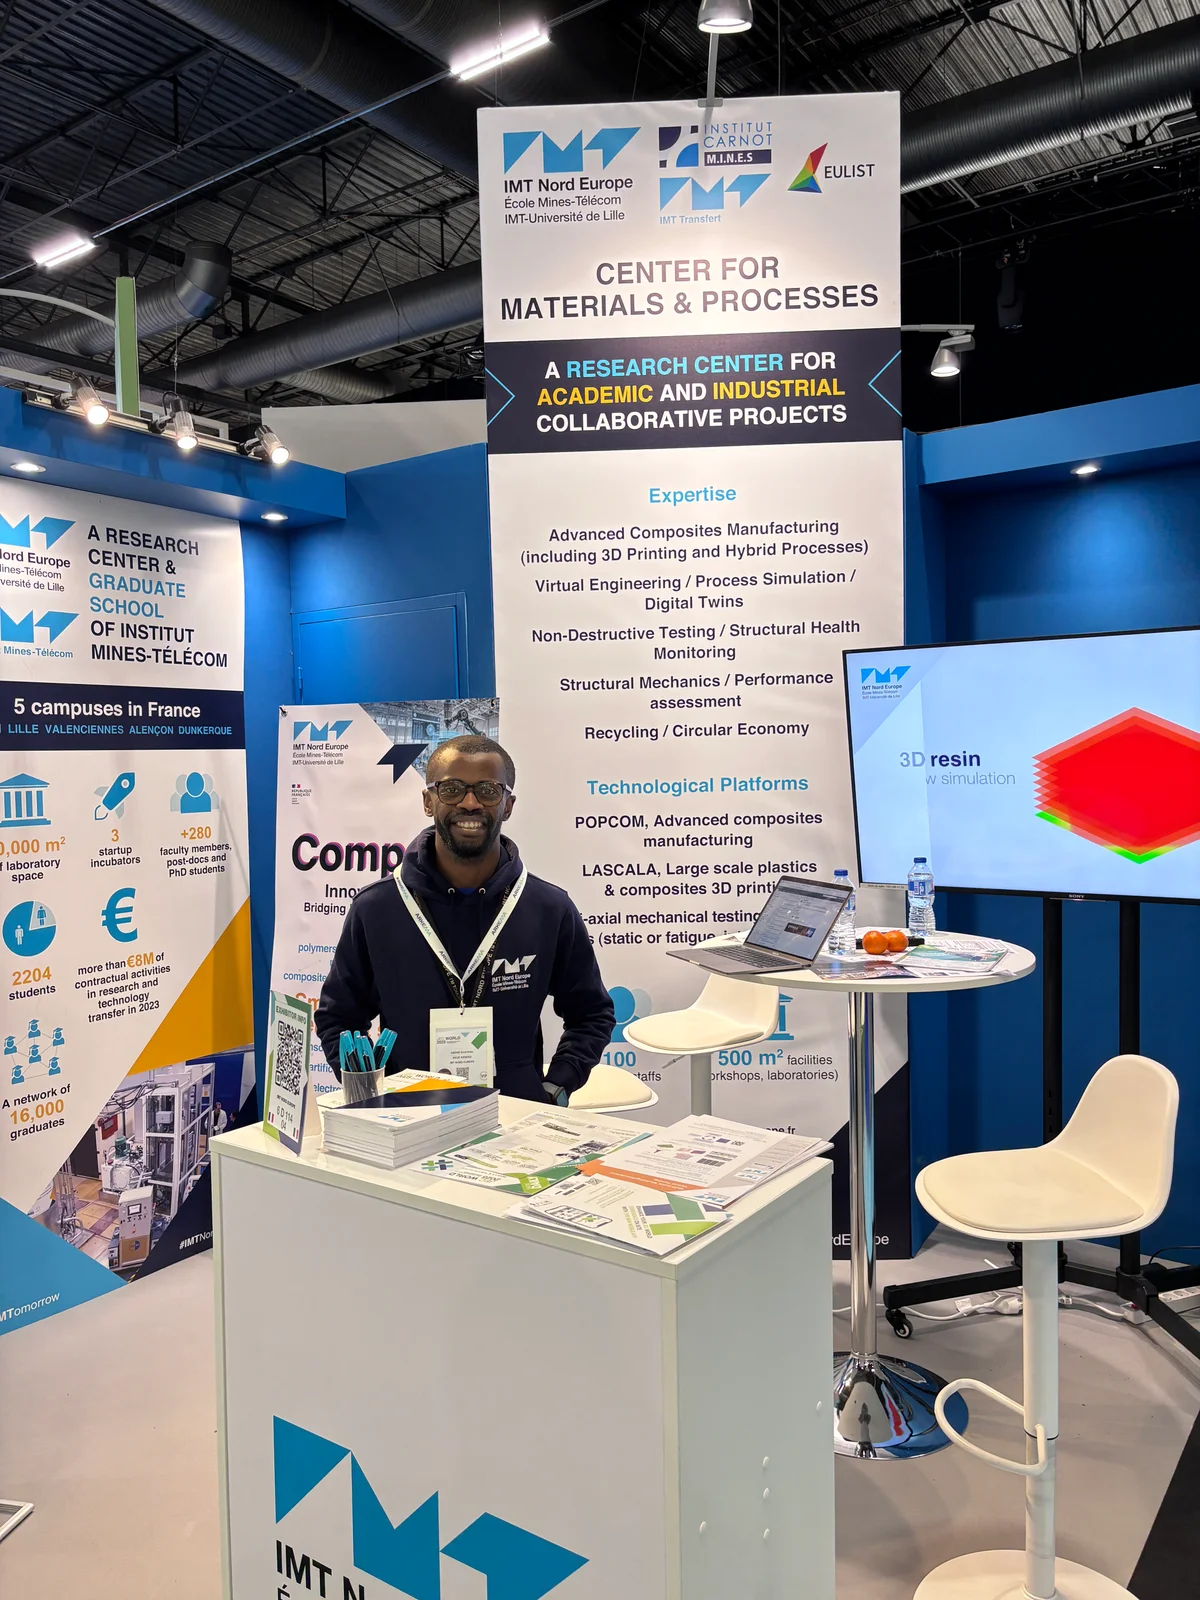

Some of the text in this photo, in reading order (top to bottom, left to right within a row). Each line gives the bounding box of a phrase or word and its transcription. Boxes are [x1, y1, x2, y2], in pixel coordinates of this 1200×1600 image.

[704, 122, 772, 134] INSTITUT
[704, 134, 772, 148] CARNOT
[706, 152, 754, 164] M.I.N.E.S
[824, 164, 875, 179] EULIST
[504, 176, 634, 193] IMT Nord Europe
[504, 194, 622, 209] École Mines-Télécom
[505, 210, 625, 224] IMT-Université de Lille
[660, 214, 722, 224] IMT Transfert
[596, 256, 780, 285] CENTER FOR
[501, 284, 879, 320] MATERIALS PROCESSES
[544, 351, 836, 378] A RESEARCH CENTER FOR
[537, 378, 846, 406] ACADEMIC AND INDUSTRIAL
[536, 404, 848, 433] COLLABORATIVE PROJECTS
[650, 486, 737, 506] Expertise
[88, 524, 200, 556] A RESEARCH
[549, 520, 840, 542] Advanced Composites Manufacturing
[28, 552, 70, 569] Europe
[88, 548, 160, 573] CENTER
[520, 539, 870, 566] (including 3D Printing and Hybrid Processes)
[34, 580, 64, 592] de Lille
[89, 572, 186, 598] GRADUATE
[535, 569, 847, 596] Virtual Engineering Process Simulation
[90, 596, 164, 618] SCHOOL
[645, 595, 744, 614] Digital Twins
[90, 620, 195, 643] OF INSTITUT
[532, 620, 861, 644] Non-Destructive Testing Structural Health
[4, 646, 74, 658] Mines-Télécom
[92, 644, 228, 668] MINES-TÉLÉCOM
[654, 645, 736, 662] Monitoring
[560, 672, 834, 692] Structural Mechanics Performance
[14, 698, 201, 719] 5 campuses in France
[650, 694, 742, 712] assessment
[8, 724, 232, 737] LILLE VALENCIENNES ALENÇON DUNKERQUE
[585, 722, 810, 743] Recycling Circular Economy
[325, 742, 349, 751] Europe
[900, 750, 980, 768] 3D resin
[587, 776, 809, 798] Technological Platforms
[942, 772, 1016, 785] simulation
[575, 812, 823, 831] POPCOM, Advanced composites
[112, 829, 120, 842] 3
[180, 826, 212, 840] +280
[644, 832, 754, 850] manufacturing
[98, 846, 132, 858] startup
[160, 846, 189, 857] faculty
[6, 859, 60, 872] laboratory
[90, 856, 141, 868] incubators
[166, 854, 226, 868] post-docs and
[582, 860, 818, 879] LASCALA, Large scale plastics
[12, 872, 44, 884] space
[169, 864, 226, 878] PhD students
[620, 881, 732, 899] composites 3D
[304, 902, 346, 916] Bridging
[626, 910, 708, 924] mechanical
[598, 932, 662, 948] (static or
[78, 952, 164, 976] more than €8M of
[12, 966, 52, 986] 2204
[74, 965, 171, 990] contractual activities
[8, 984, 56, 1001] students
[87, 977, 158, 999] in research and
[98, 992, 150, 1009] technology
[88, 1000, 160, 1023] transfer in 2023
[718, 1050, 833, 1066] 500 facilities
[768, 1069, 838, 1082] laboratories)
[2, 1083, 71, 1110] A network of
[10, 1099, 64, 1125] 16,000
[10, 1117, 65, 1141] graduates
[276, 1540, 332, 1598] IMT
